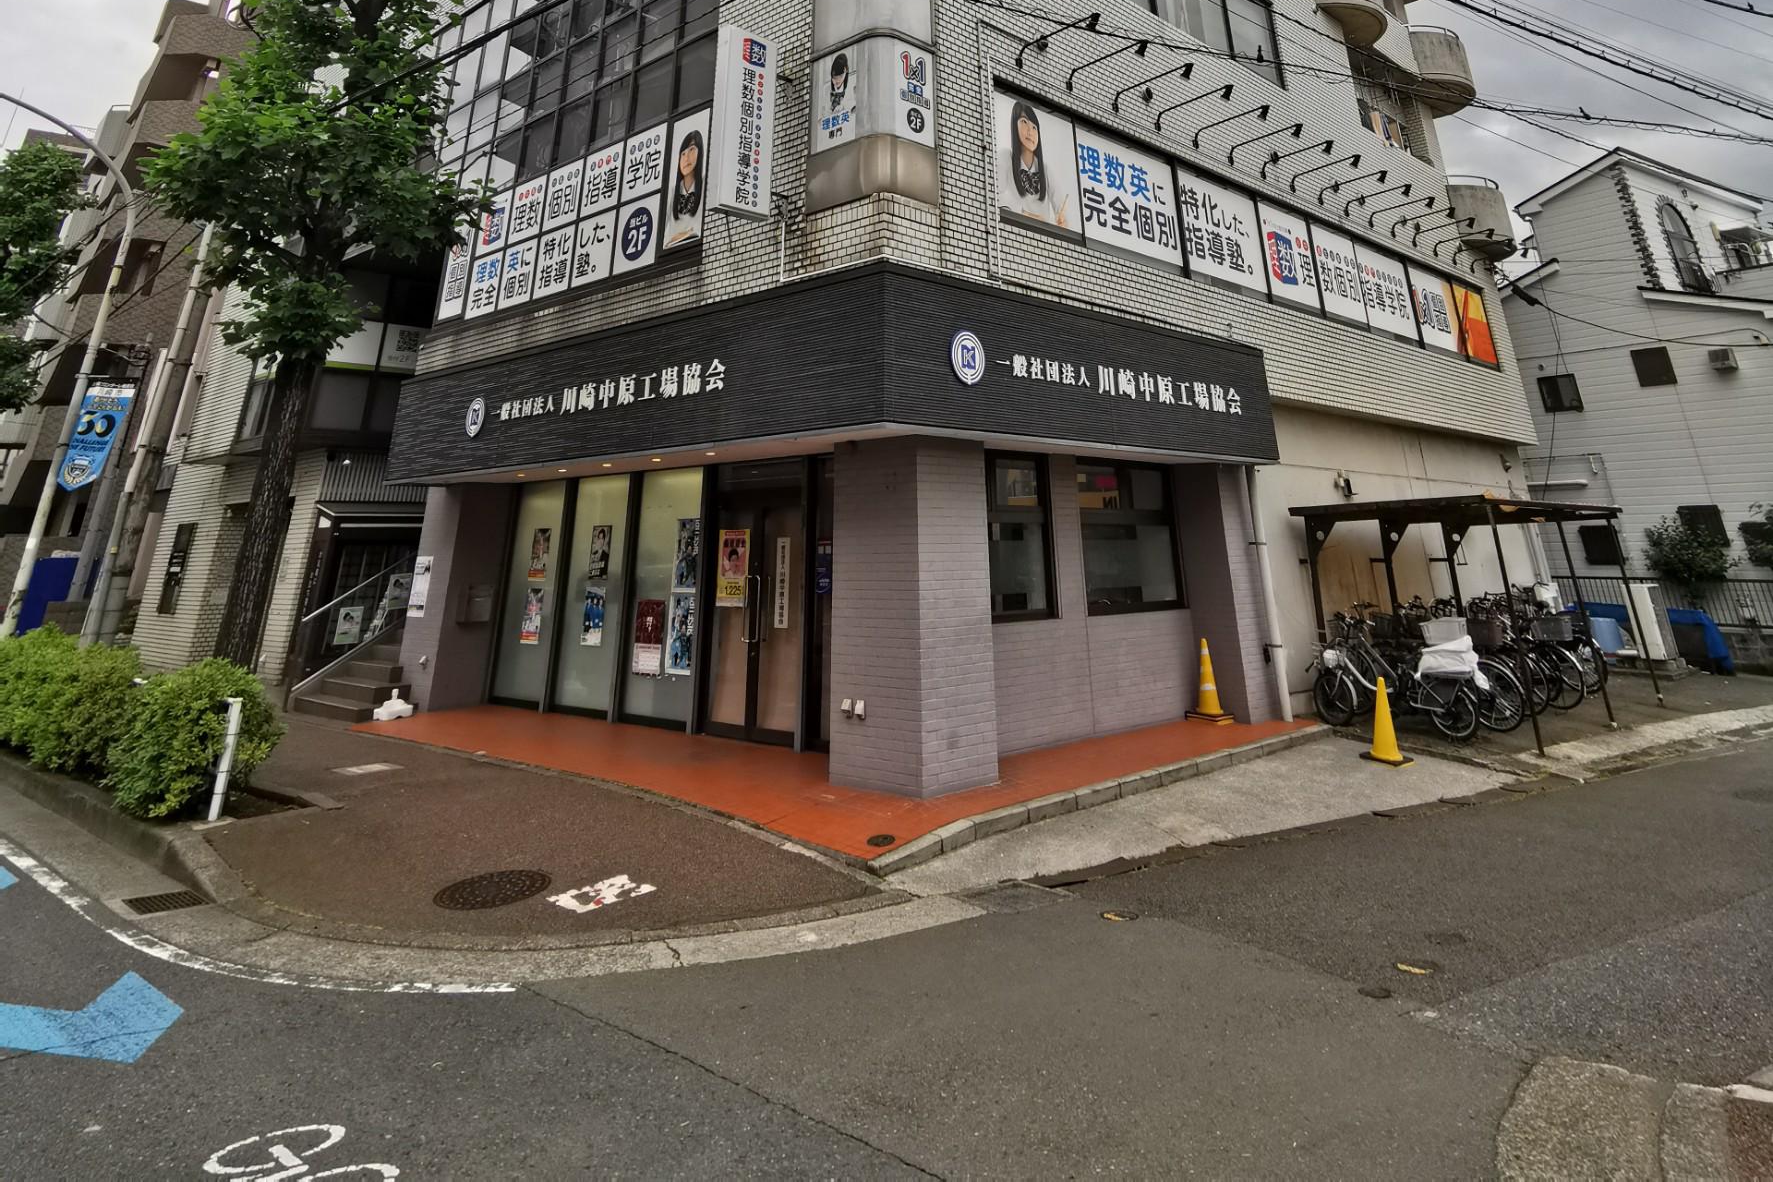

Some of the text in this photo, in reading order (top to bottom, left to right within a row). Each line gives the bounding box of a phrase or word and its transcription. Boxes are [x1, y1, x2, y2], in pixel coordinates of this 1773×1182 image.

[735, 67, 756, 205] 理数個別指導学院
[910, 116, 922, 130] 2F
[512, 149, 661, 234] 理数個別指導学院
[625, 226, 647, 255] 2F
[490, 358, 726, 421] 一般社団法人 川崎中原工場協会
[996, 353, 1242, 415] 一般社団法人 川崎中原工場協会
